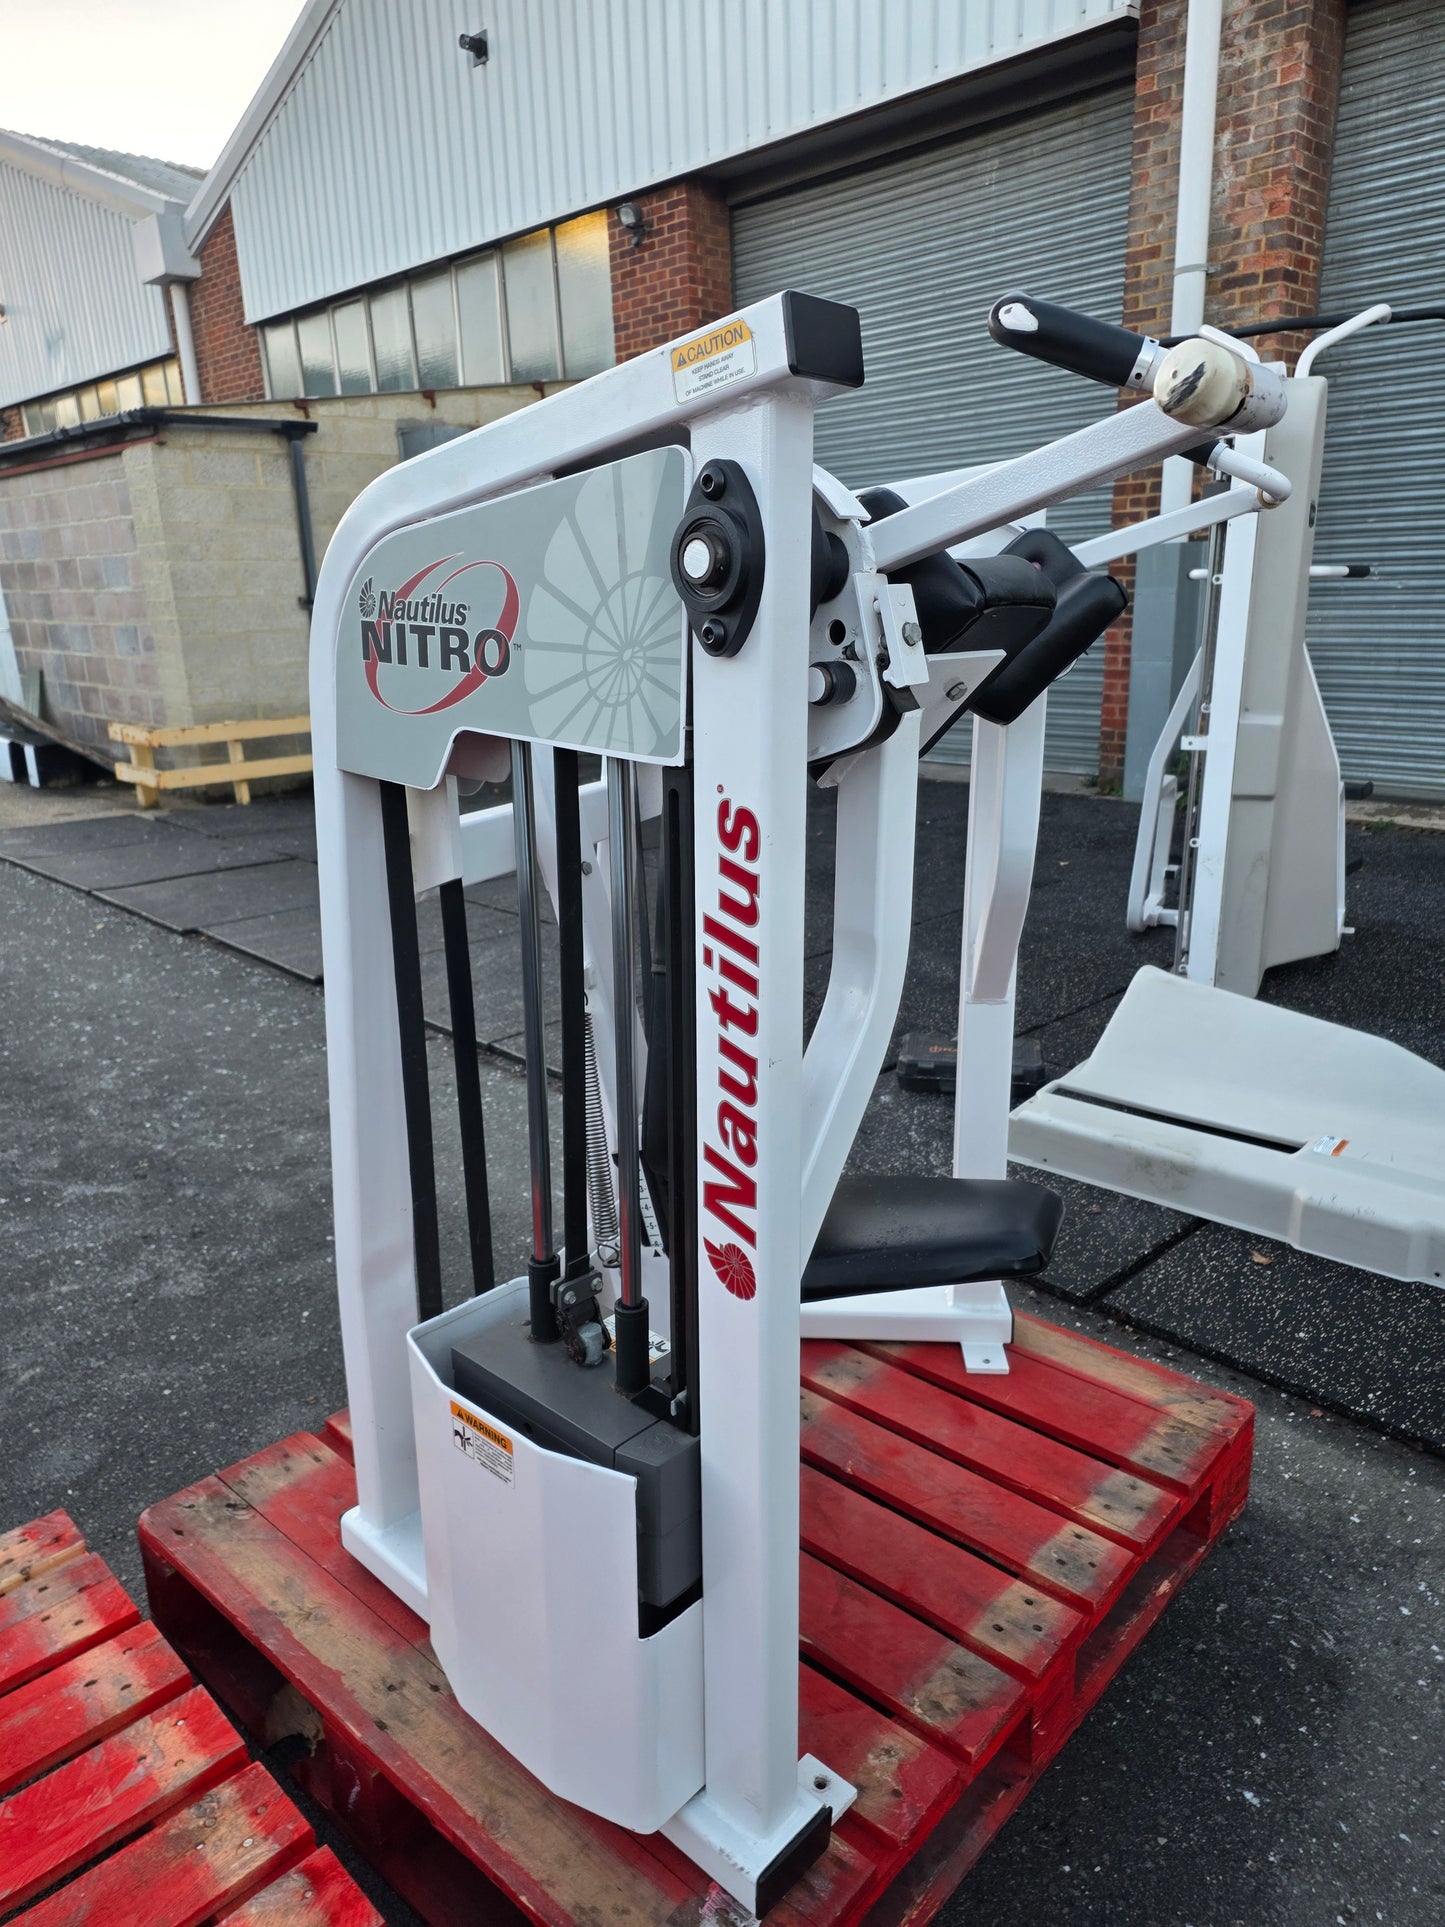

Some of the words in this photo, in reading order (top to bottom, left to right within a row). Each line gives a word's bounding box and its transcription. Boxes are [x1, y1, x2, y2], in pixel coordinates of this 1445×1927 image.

[687, 325, 743, 362] CAUTION
[692, 366, 703, 374] KEEP
[721, 352, 734, 363] AWAY
[698, 371, 713, 381] STAND
[714, 364, 729, 374] CLEAR
[692, 381, 712, 393] MACHINE
[714, 374, 728, 384] WHILE
[378, 590, 468, 626] Nautilus
[360, 620, 511, 677] NITRO
[703, 798, 761, 1250] Nautilus
[465, 1413, 507, 1450] WARNING
